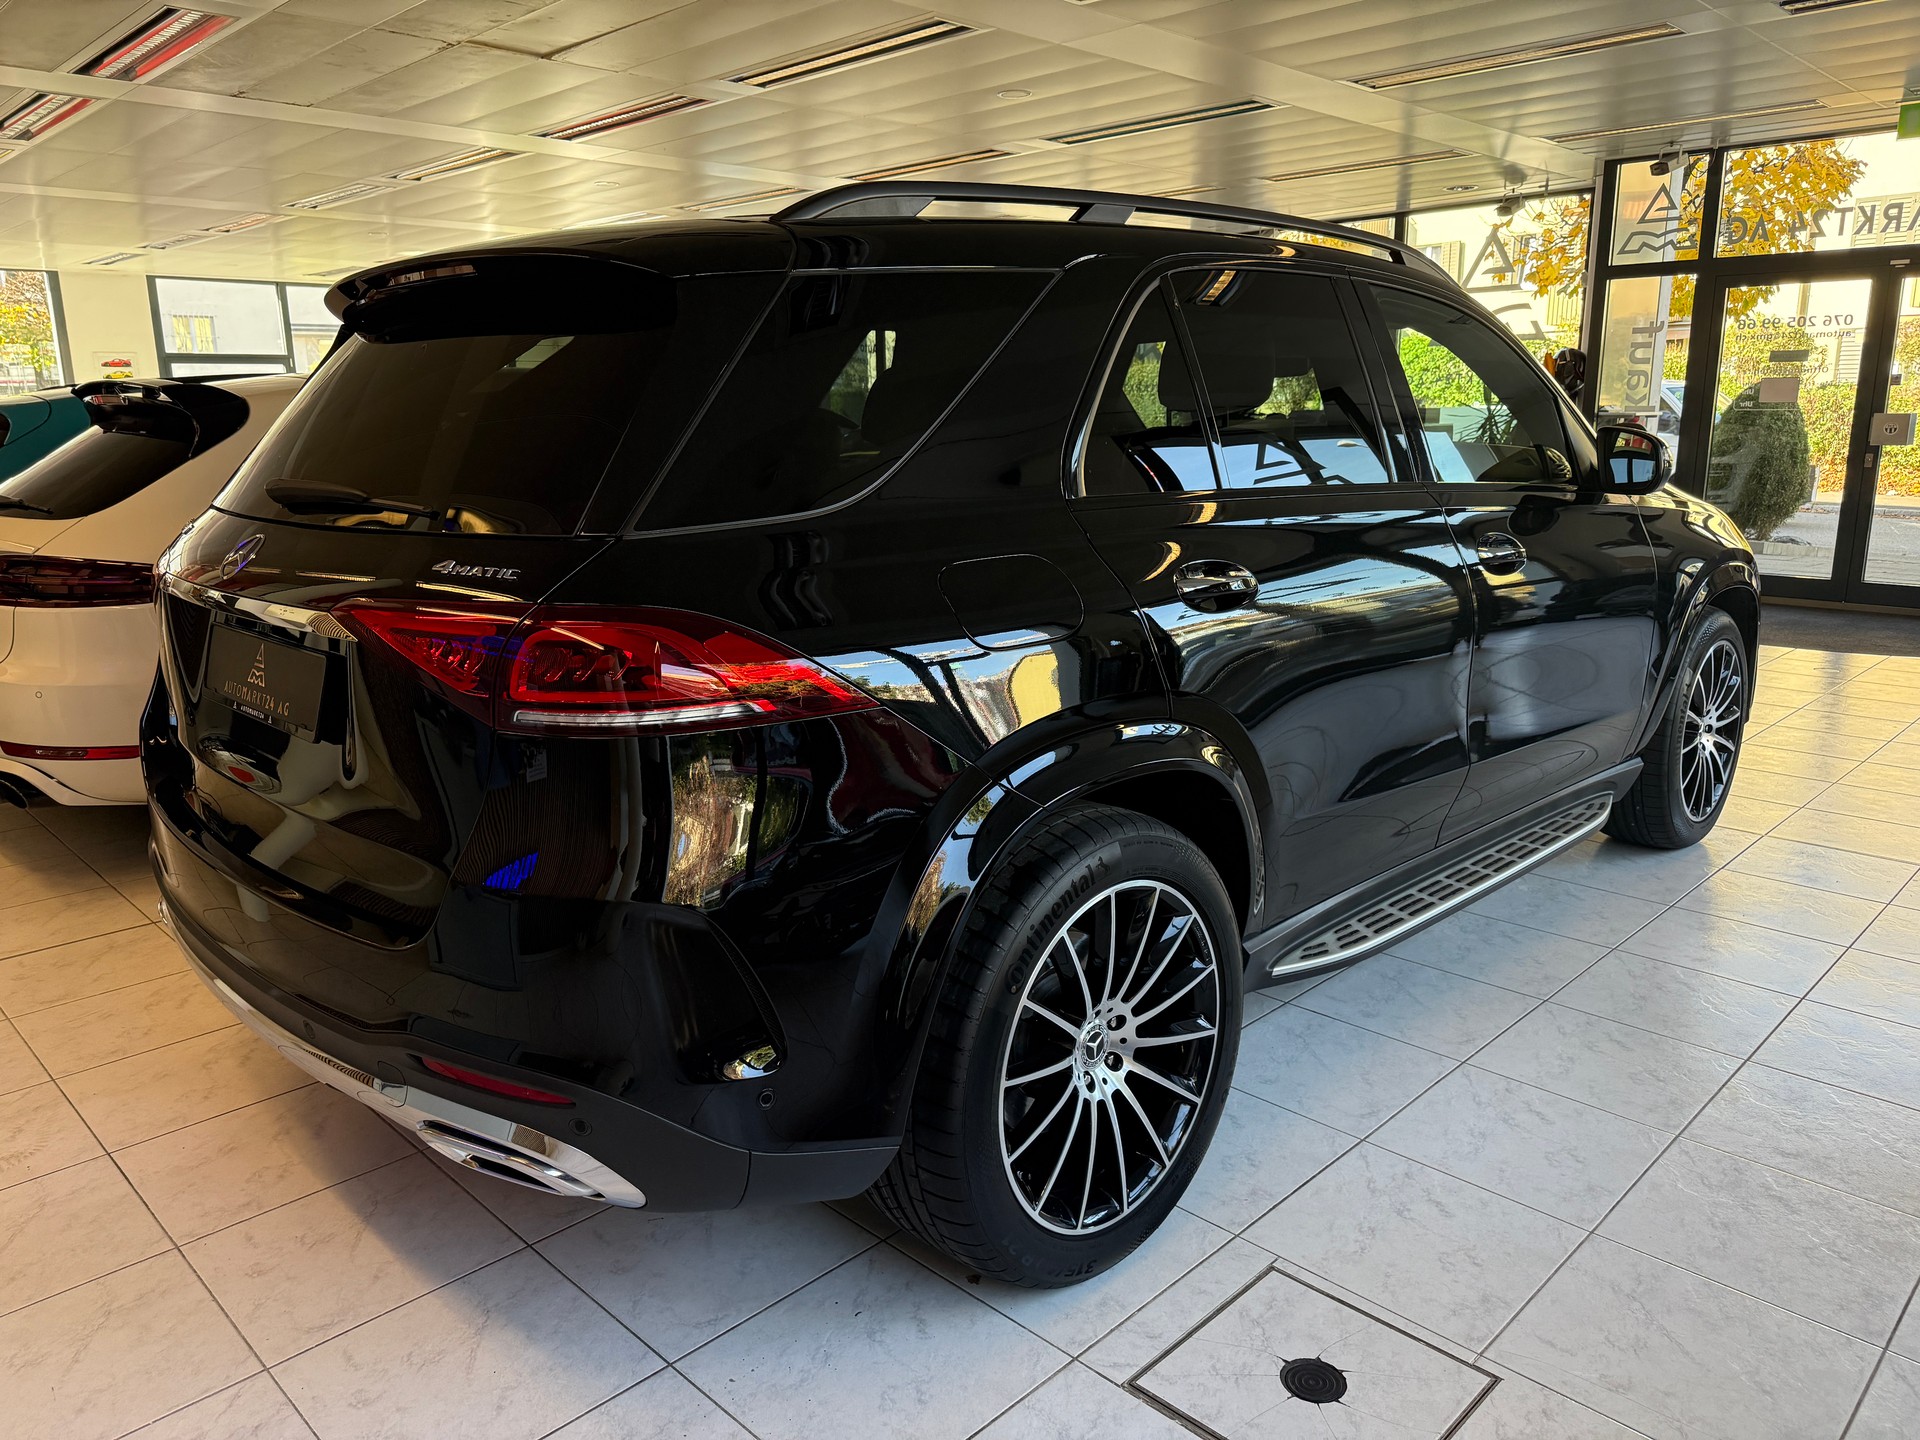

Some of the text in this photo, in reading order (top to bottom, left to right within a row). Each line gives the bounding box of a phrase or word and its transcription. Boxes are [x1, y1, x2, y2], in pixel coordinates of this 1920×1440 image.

[431, 559, 521, 579] 4MATIC
[223, 680, 290, 716] AUTOMARKT24 AG
[1006, 862, 1097, 994] Continental
